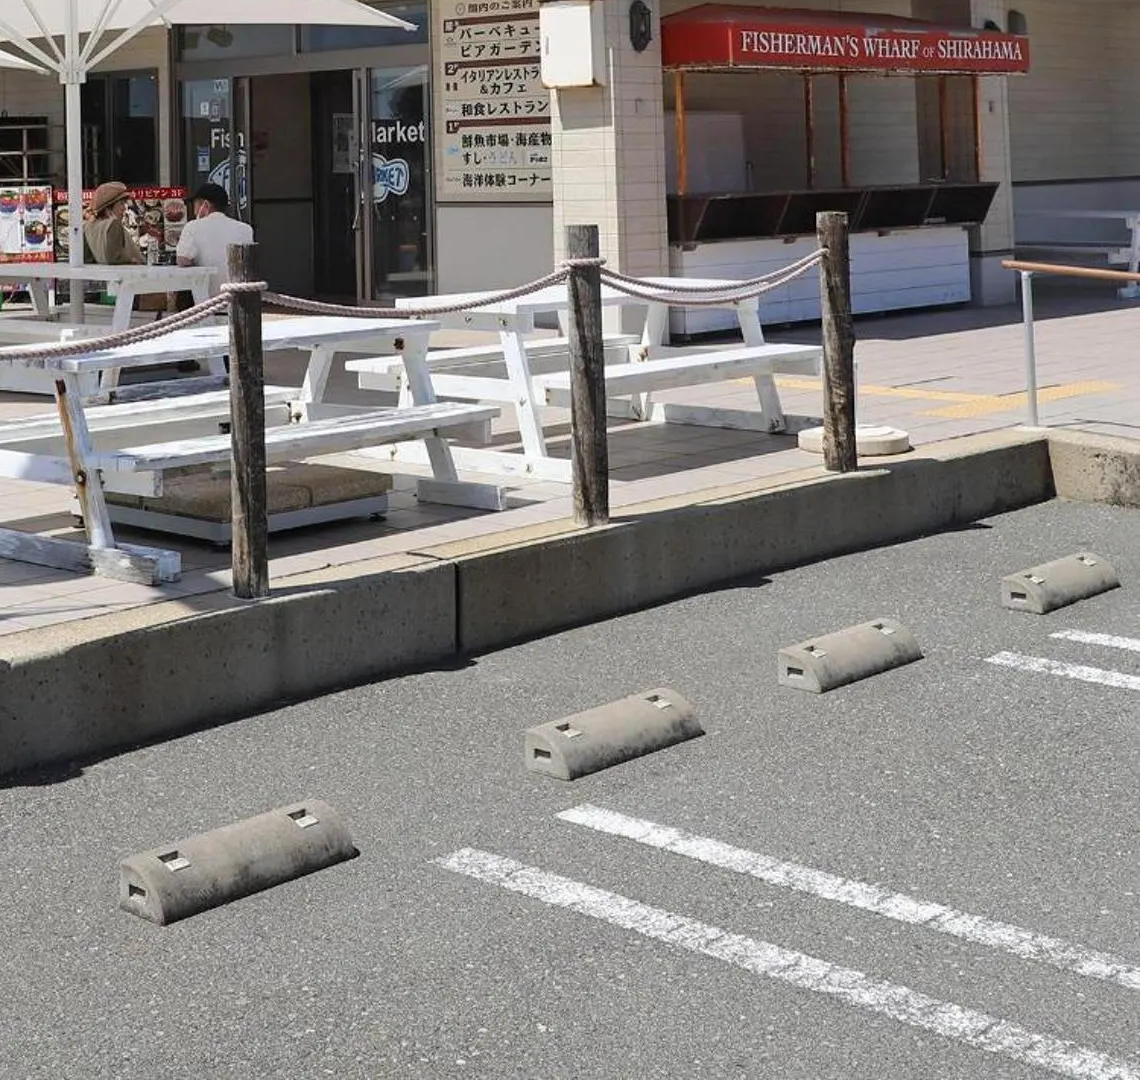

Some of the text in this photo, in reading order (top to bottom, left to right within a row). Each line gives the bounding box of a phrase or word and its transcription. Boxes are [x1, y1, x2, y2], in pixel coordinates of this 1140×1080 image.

[468, 0, 533, 13] 館内のご案内
[740, 30, 1022, 60] FISHERMAN'S WHARF OF SHIRAHAMA
[461, 65, 540, 83] イタリアンレストラ
[480, 82, 527, 95] &カフェ
[461, 100, 549, 117] 和食レストラン
[462, 172, 551, 188] 海洋体験コーナー
